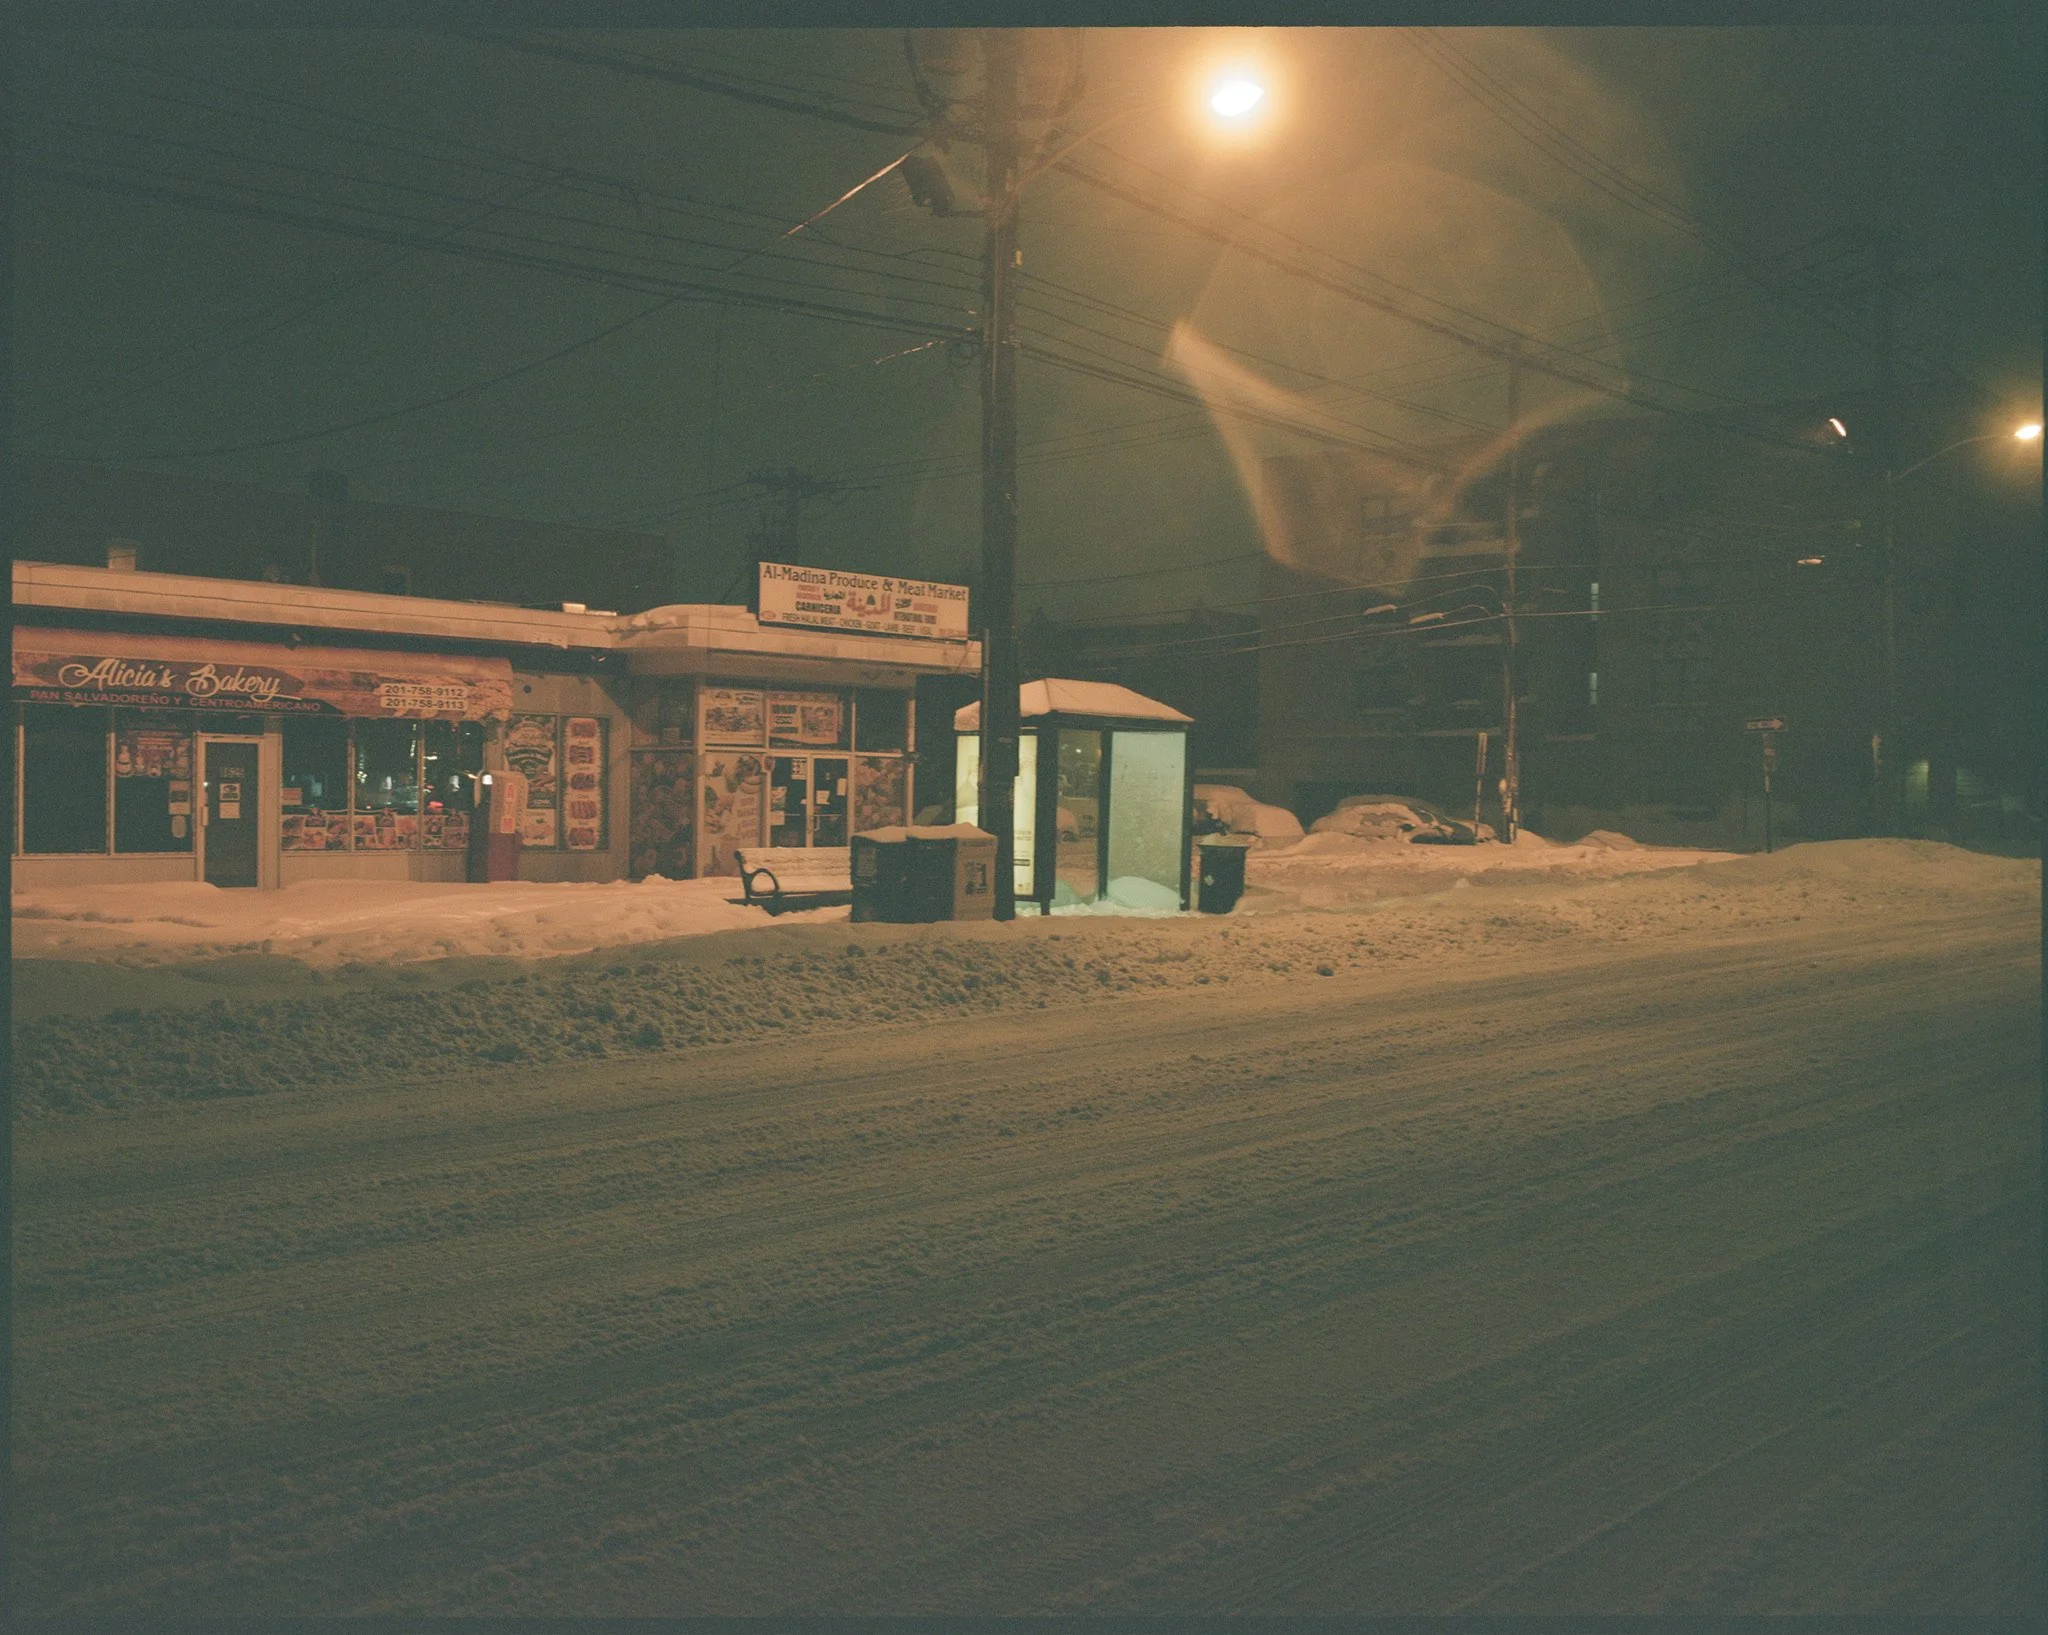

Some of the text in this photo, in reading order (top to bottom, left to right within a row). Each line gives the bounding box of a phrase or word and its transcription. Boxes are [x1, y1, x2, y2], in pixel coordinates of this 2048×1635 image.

[763, 565, 827, 585] Al-Madina
[829, 572, 878, 591] Produce
[882, 578, 893, 592] &
[897, 581, 925, 596] Meat
[927, 584, 967, 601] Market
[58, 658, 302, 702] Alicia's Bakery
[30, 690, 60, 700] PAN
[63, 691, 170, 705] SALVADOREÑO
[174, 696, 182, 705] Y
[385, 685, 464, 698] 201-758-9112
[385, 698, 465, 710] 201-758-9113
